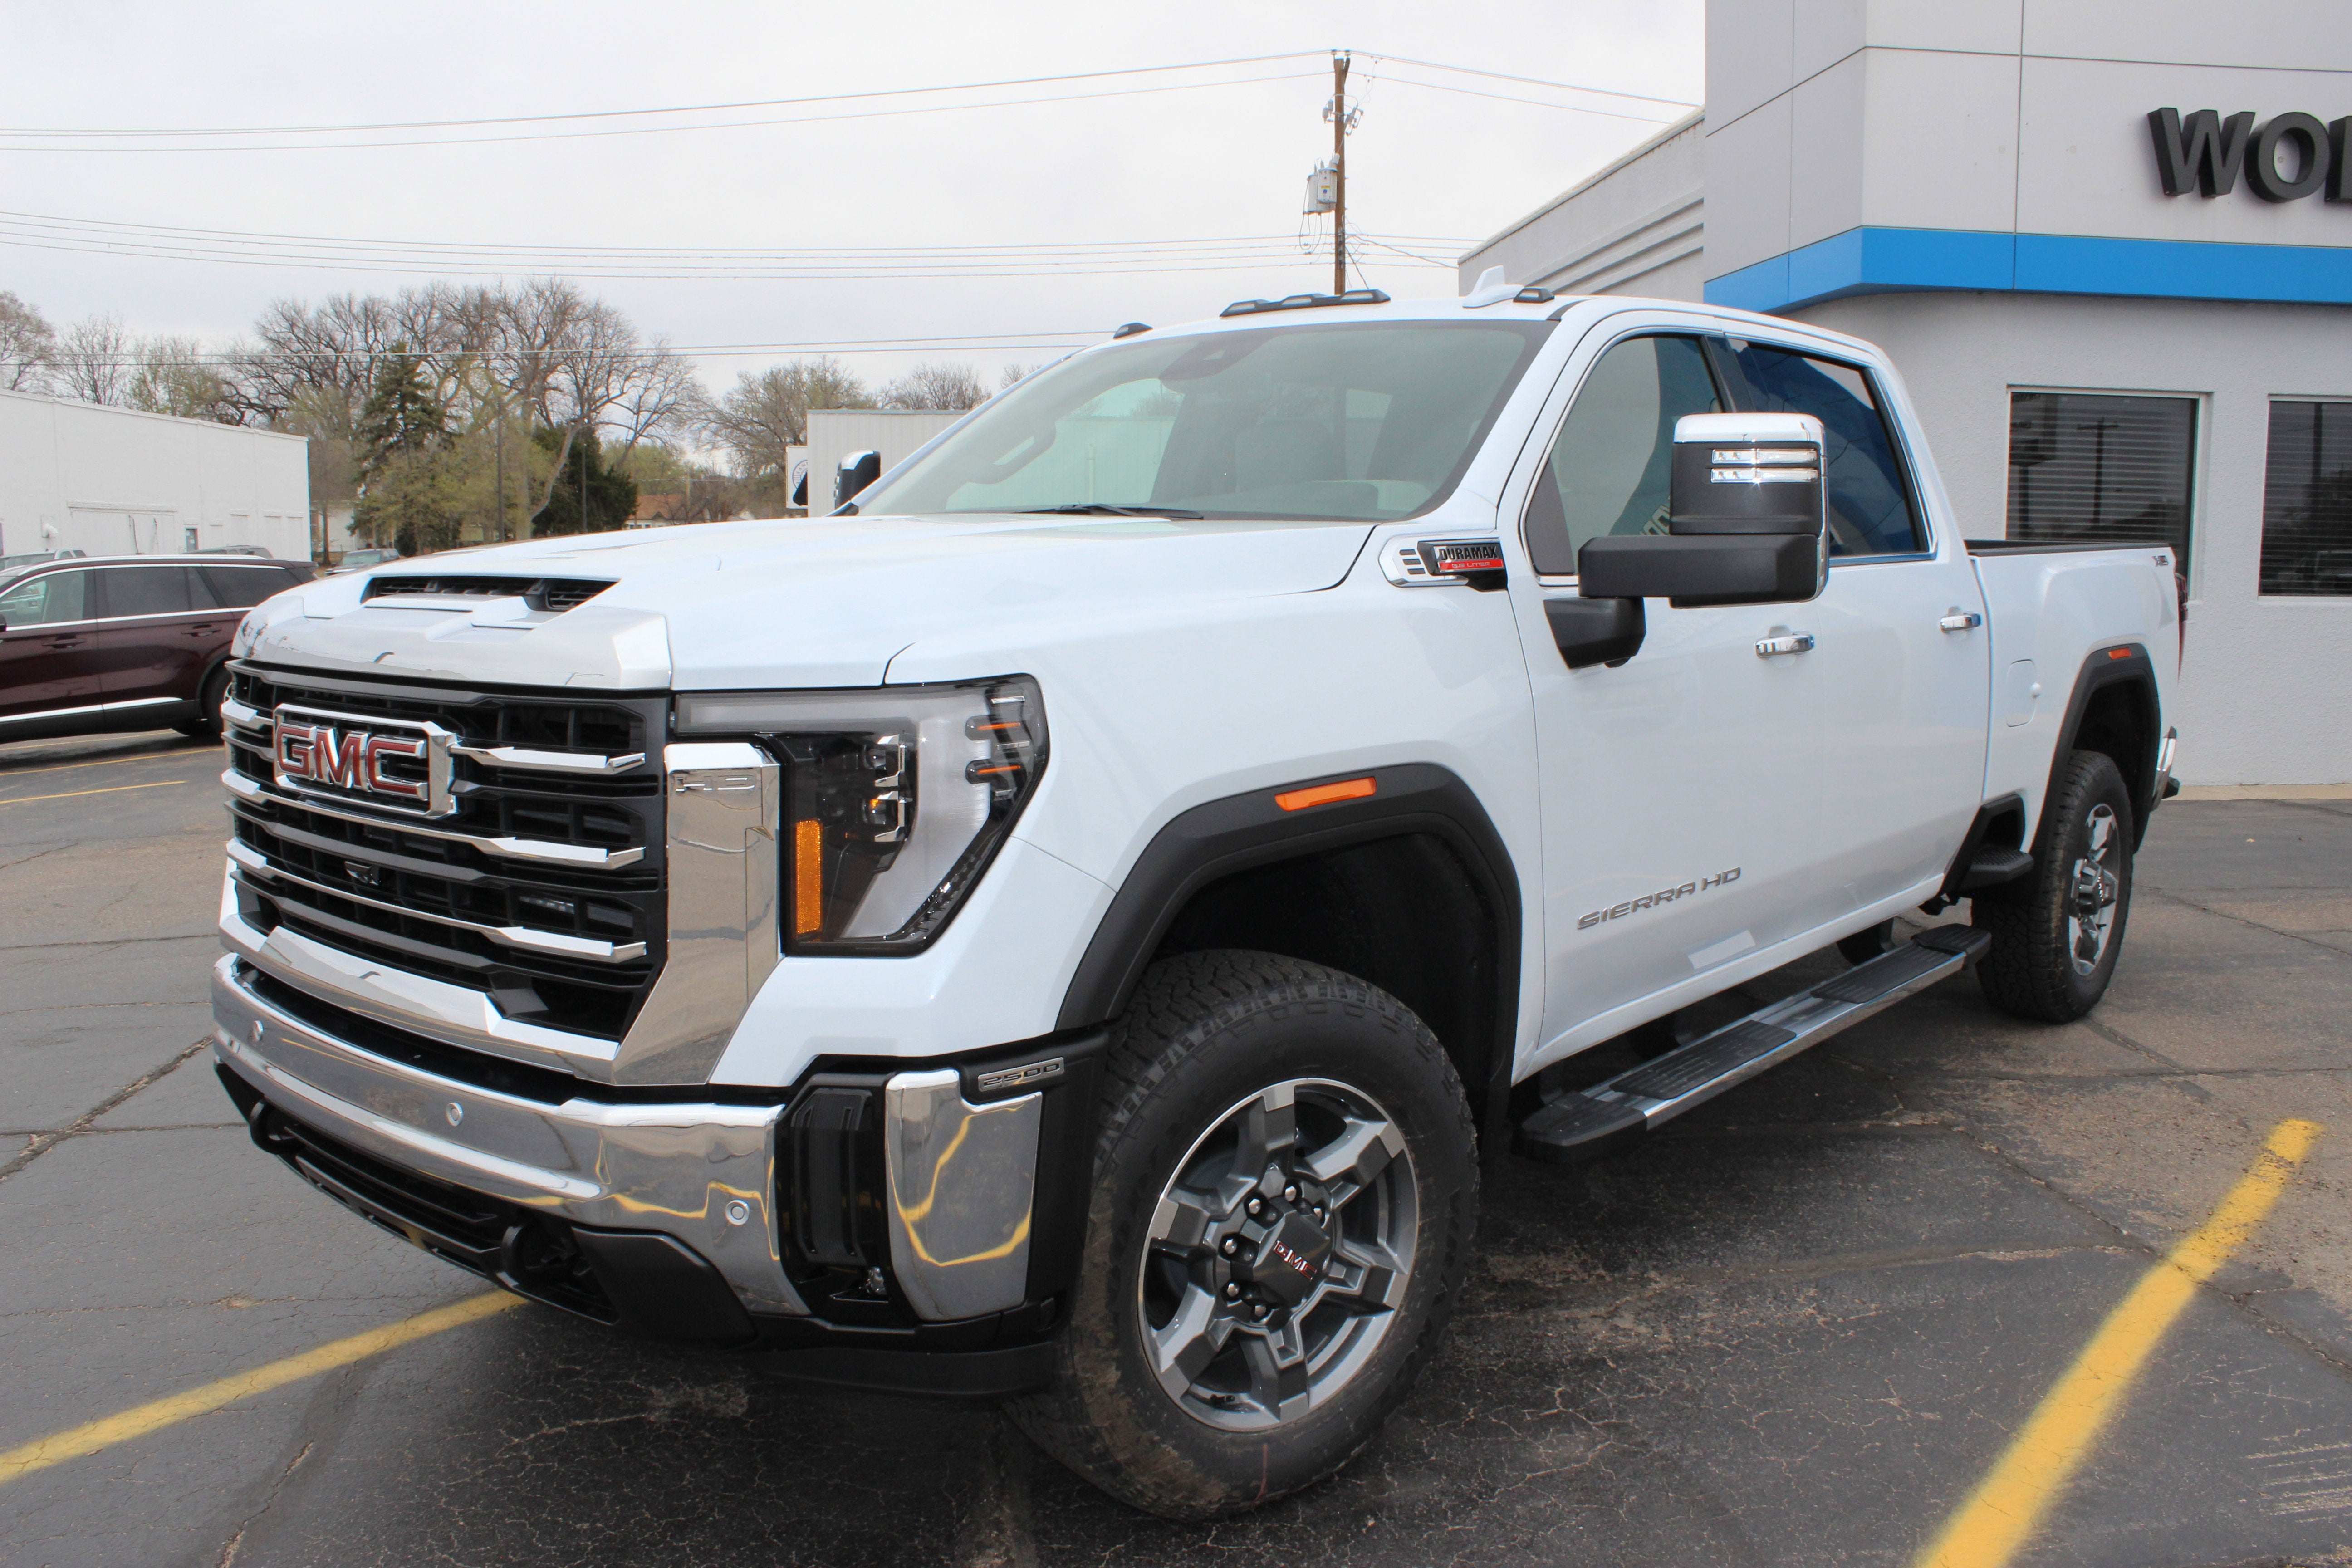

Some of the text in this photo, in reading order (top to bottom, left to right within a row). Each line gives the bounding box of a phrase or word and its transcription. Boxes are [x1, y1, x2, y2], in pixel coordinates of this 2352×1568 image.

[1439, 546, 1498, 561] DURAMAX
[275, 722, 428, 801] GMC
[1577, 867, 1741, 930] SIERRA HD
[984, 1064, 1060, 1086] 2500
[1273, 1240, 1317, 1280] GMC
